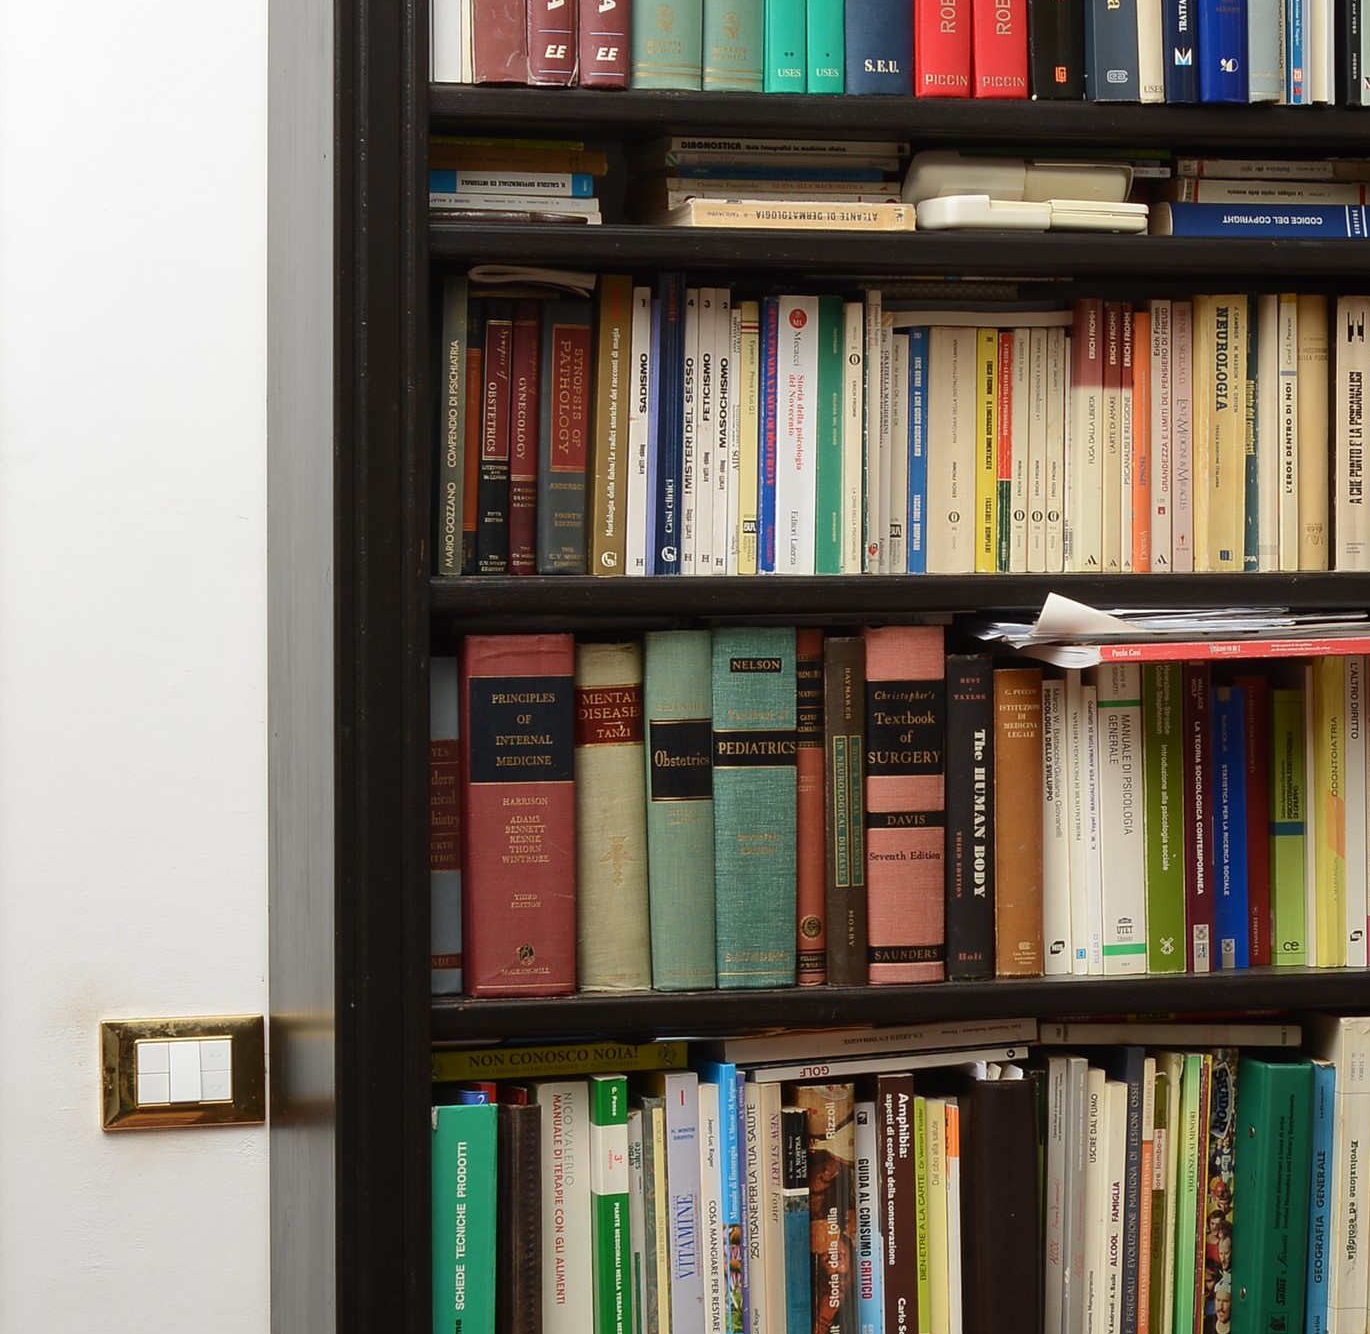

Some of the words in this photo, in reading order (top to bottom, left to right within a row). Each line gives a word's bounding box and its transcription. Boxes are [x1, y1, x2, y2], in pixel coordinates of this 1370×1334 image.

[864, 59, 900, 73] S.E.U.
[925, 73, 968, 86] PICCIN
[1223, 215, 1271, 225] COPYRIGHT
[1273, 215, 1289, 225] DEL
[1291, 215, 1322, 225] CODICE
[1216, 306, 1229, 412] NEUROLOGIA
[639, 353, 648, 414] SADISMO
[703, 353, 711, 422] FETICISMO
[557, 340, 572, 454] PATHOLOGY
[719, 357, 729, 449] MASOCHISMO
[487, 382, 497, 453] OBSTETRICS
[516, 377, 527, 459] GYNECOLOGY
[732, 659, 780, 671] NELSON
[492, 693, 555, 704] PRINCIPLES
[517, 714, 532, 724] OF
[874, 712, 936, 725] Textbook
[496, 735, 553, 745] INTERNAL
[717, 741, 796, 757] PEDIATRICS
[974, 730, 985, 761] The
[496, 755, 552, 766] MEDICINE
[655, 751, 710, 767] Obstetrics
[868, 749, 941, 766] SURGERY
[1330, 717, 1338, 797] ODONTOIATRIA
[973, 767, 985, 839] HUMAN
[887, 814, 925, 826] DAVIS
[973, 845, 985, 898] BODY
[874, 949, 938, 961] SAUNDERS
[468, 1054, 506, 1068] NON
[511, 1050, 589, 1066] CONOSCO
[898, 1093, 909, 1159] Amphibia:
[457, 1142, 467, 1198] PRODOTTI
[456, 1204, 466, 1258] TECNICHE
[678, 1194, 695, 1280] VITAMINE
[455, 1264, 465, 1310] SCHEDE
